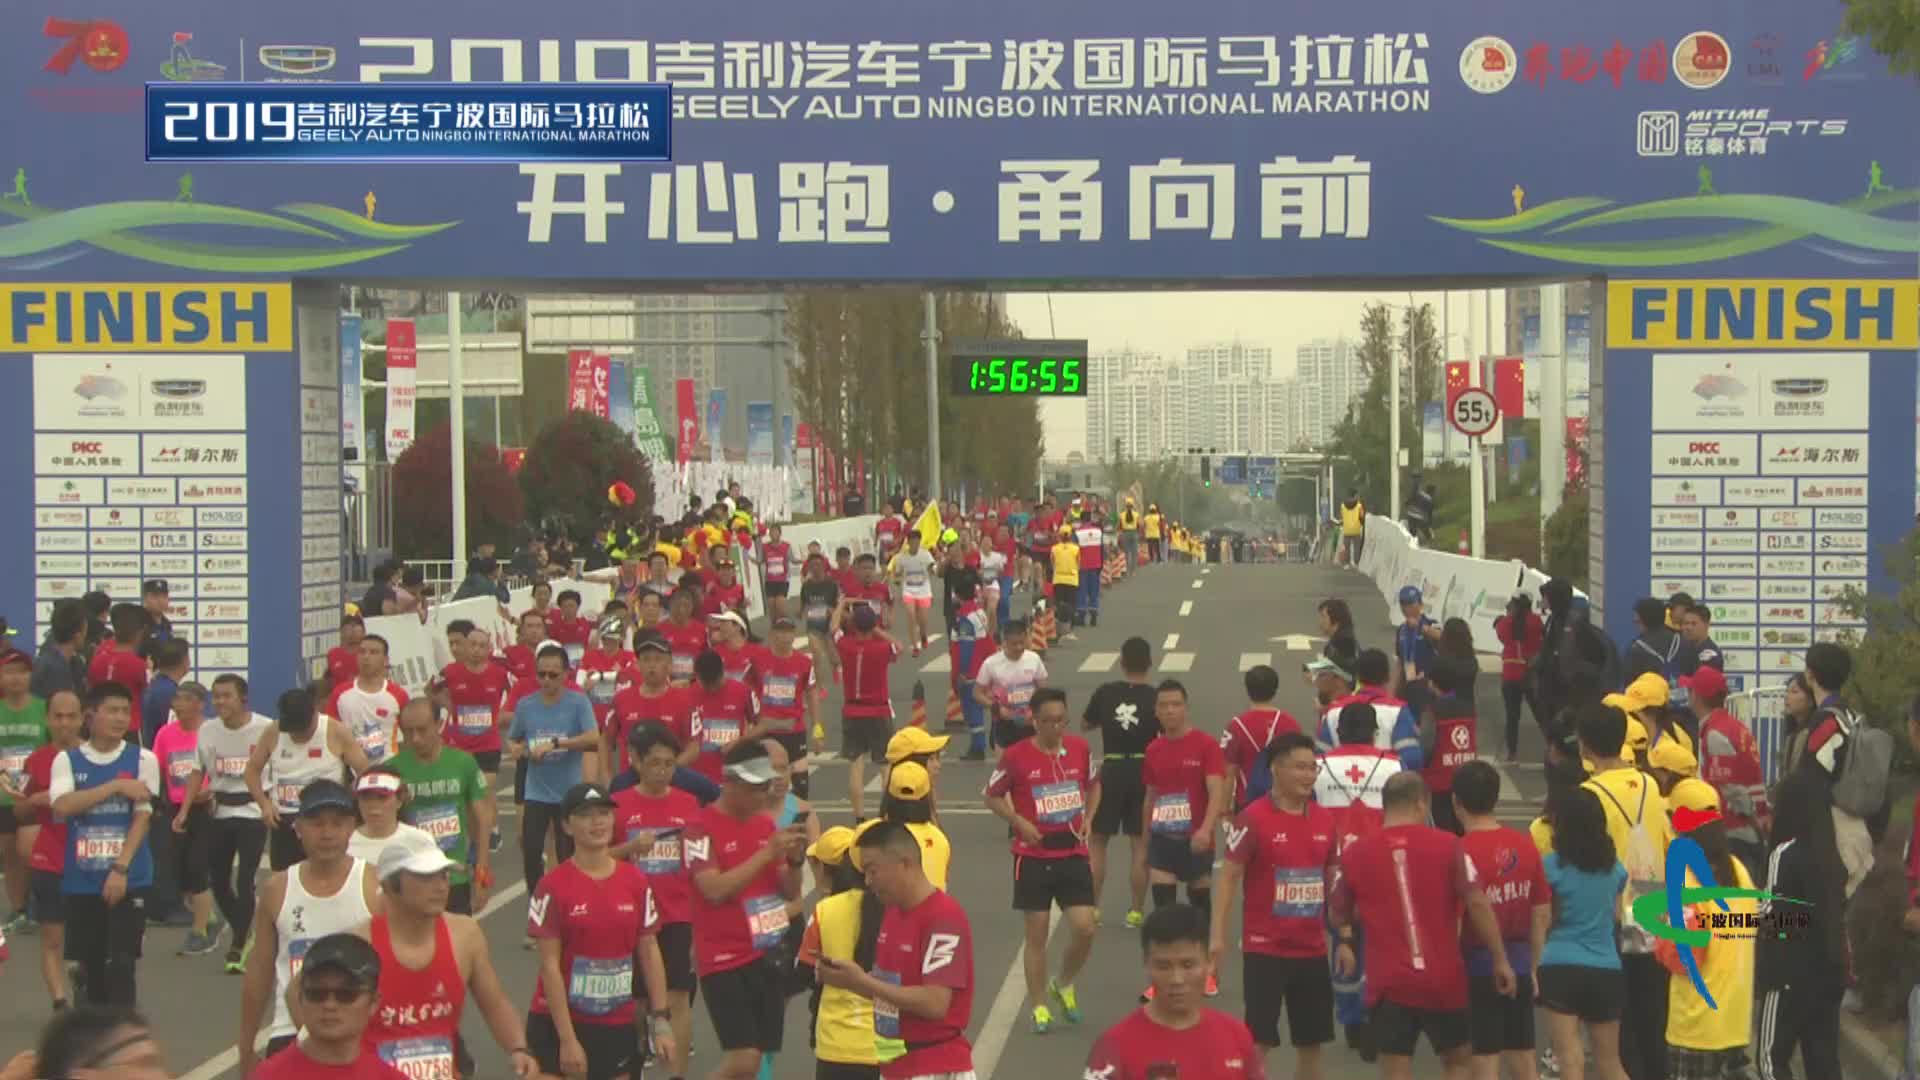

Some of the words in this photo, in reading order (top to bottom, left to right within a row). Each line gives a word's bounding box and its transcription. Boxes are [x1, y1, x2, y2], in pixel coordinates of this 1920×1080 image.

[655, 33, 1430, 91] 吉利汽车宁波国际马拉松
[804, 96, 921, 119] AUTO
[928, 95, 1035, 119] NINGBO
[1042, 92, 1265, 117] INTERNATIONAL
[1272, 89, 1430, 113] MARATHON
[1685, 108, 1769, 120] MITIME
[1684, 119, 1849, 136] SPORTS
[1684, 137, 1769, 156] 铭泰体育
[11, 290, 268, 344] FINISH
[1631, 287, 1895, 341] FINISH
[970, 359, 1080, 393] 1:56:55
[71, 441, 103, 454] PICC
[183, 448, 239, 463] 海尔斯
[1689, 441, 1720, 454] PICC
[1802, 447, 1860, 463] 海尔斯
